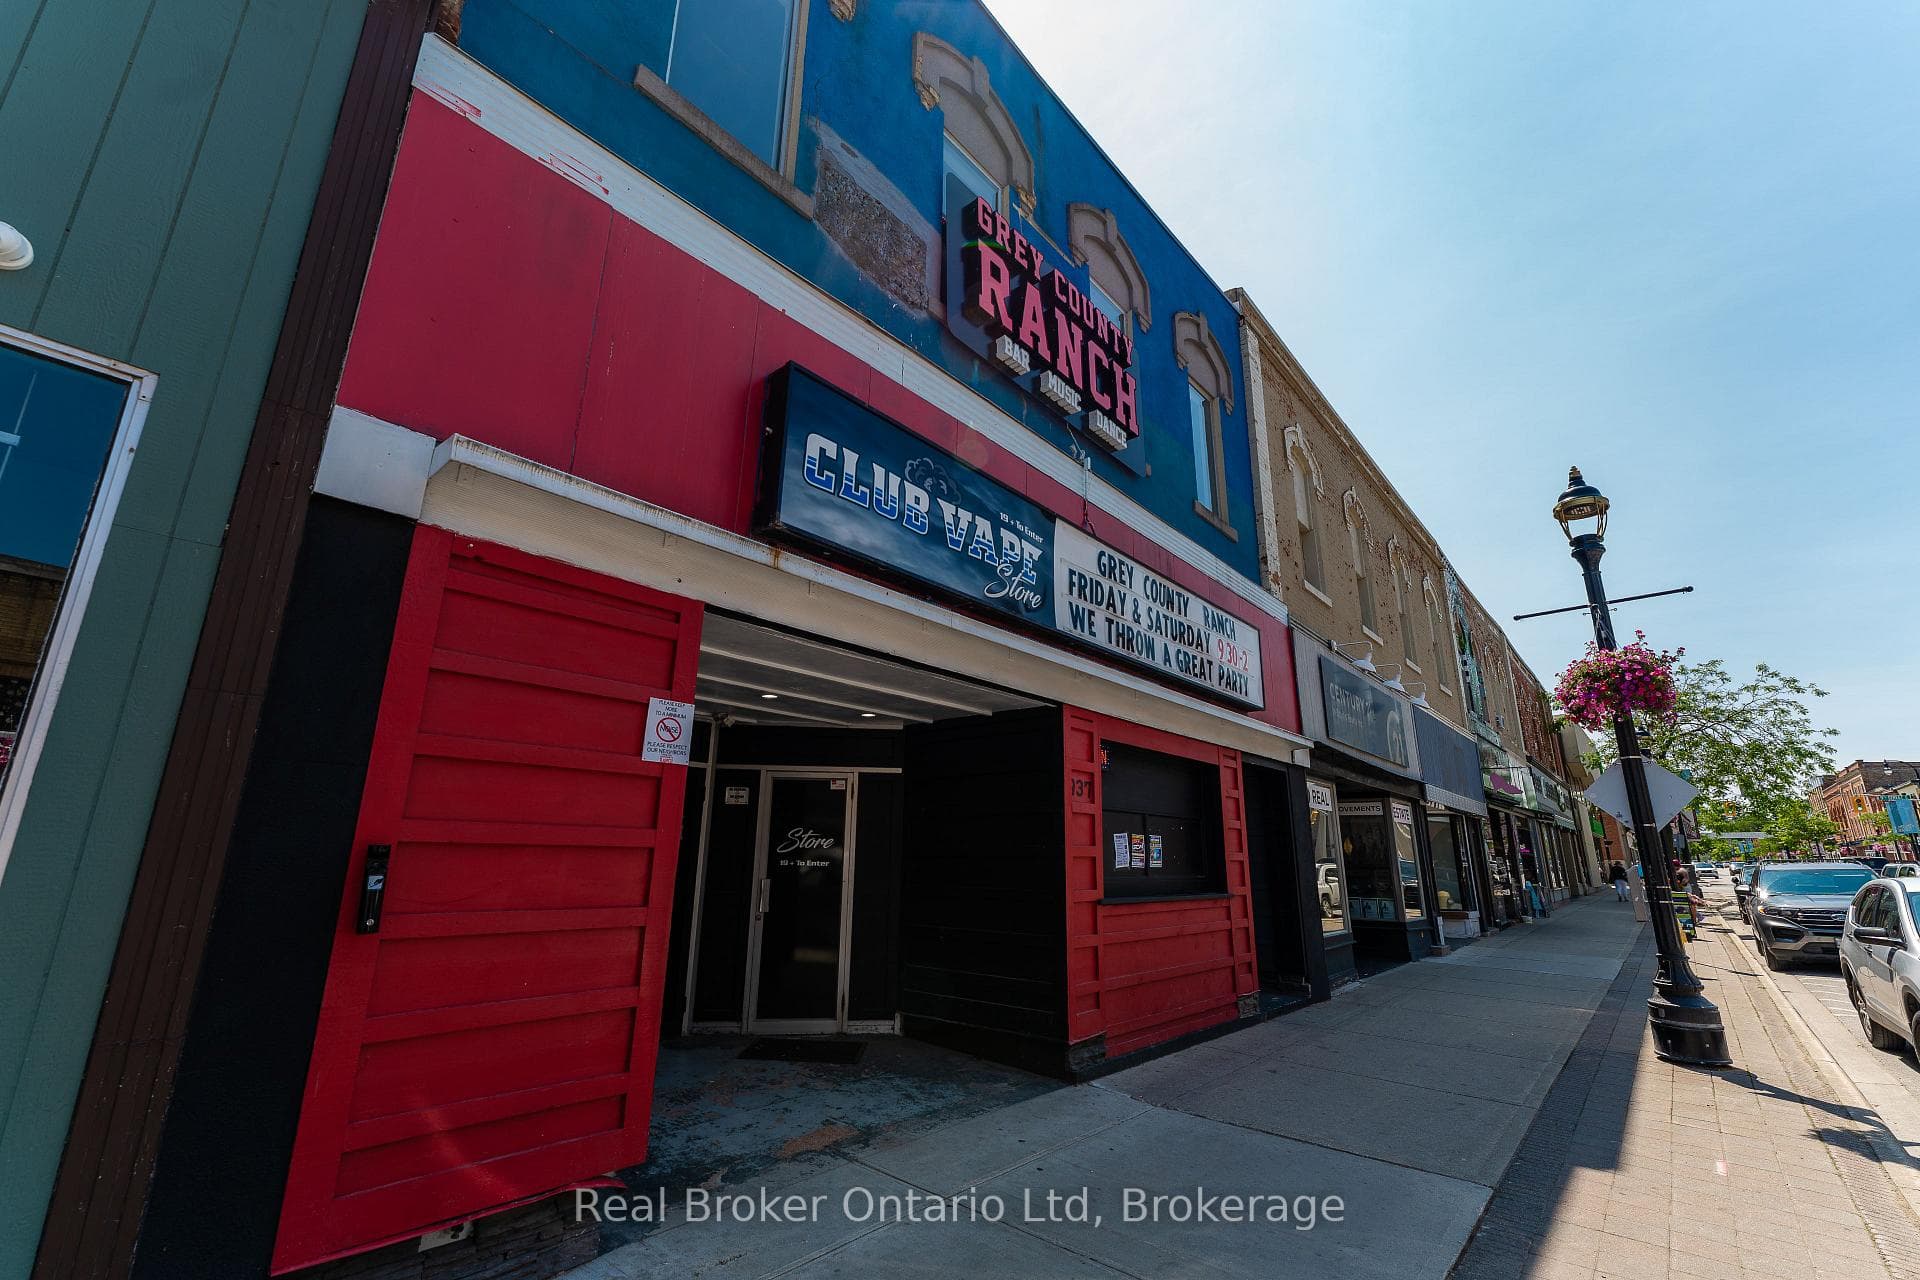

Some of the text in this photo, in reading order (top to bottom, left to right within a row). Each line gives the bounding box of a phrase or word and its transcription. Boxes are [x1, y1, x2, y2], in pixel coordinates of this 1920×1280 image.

[977, 195, 1133, 366] GREY COUNTY
[978, 239, 1139, 436] RANCH
[1004, 335, 1030, 372] BAR
[1047, 372, 1081, 413] MUSIC
[1096, 409, 1128, 449] DANCE
[803, 432, 1044, 585] CLUB VAPE
[1000, 512, 1009, 522] 19
[1015, 519, 1024, 532] To
[1024, 524, 1044, 544] Enter
[984, 563, 1042, 608] Store
[1098, 550, 1236, 641] GREY COUNTY RANCH
[1068, 568, 1126, 617] FRIDAY
[1132, 597, 1142, 624] &
[1147, 606, 1211, 653] SATURDAY
[1068, 601, 1249, 697] WE THROW A GREAT PARTY
[660, 724, 679, 734] NOISE
[1311, 789, 1330, 807] REAL
[776, 827, 835, 853] Store
[806, 859, 830, 867] Enter
